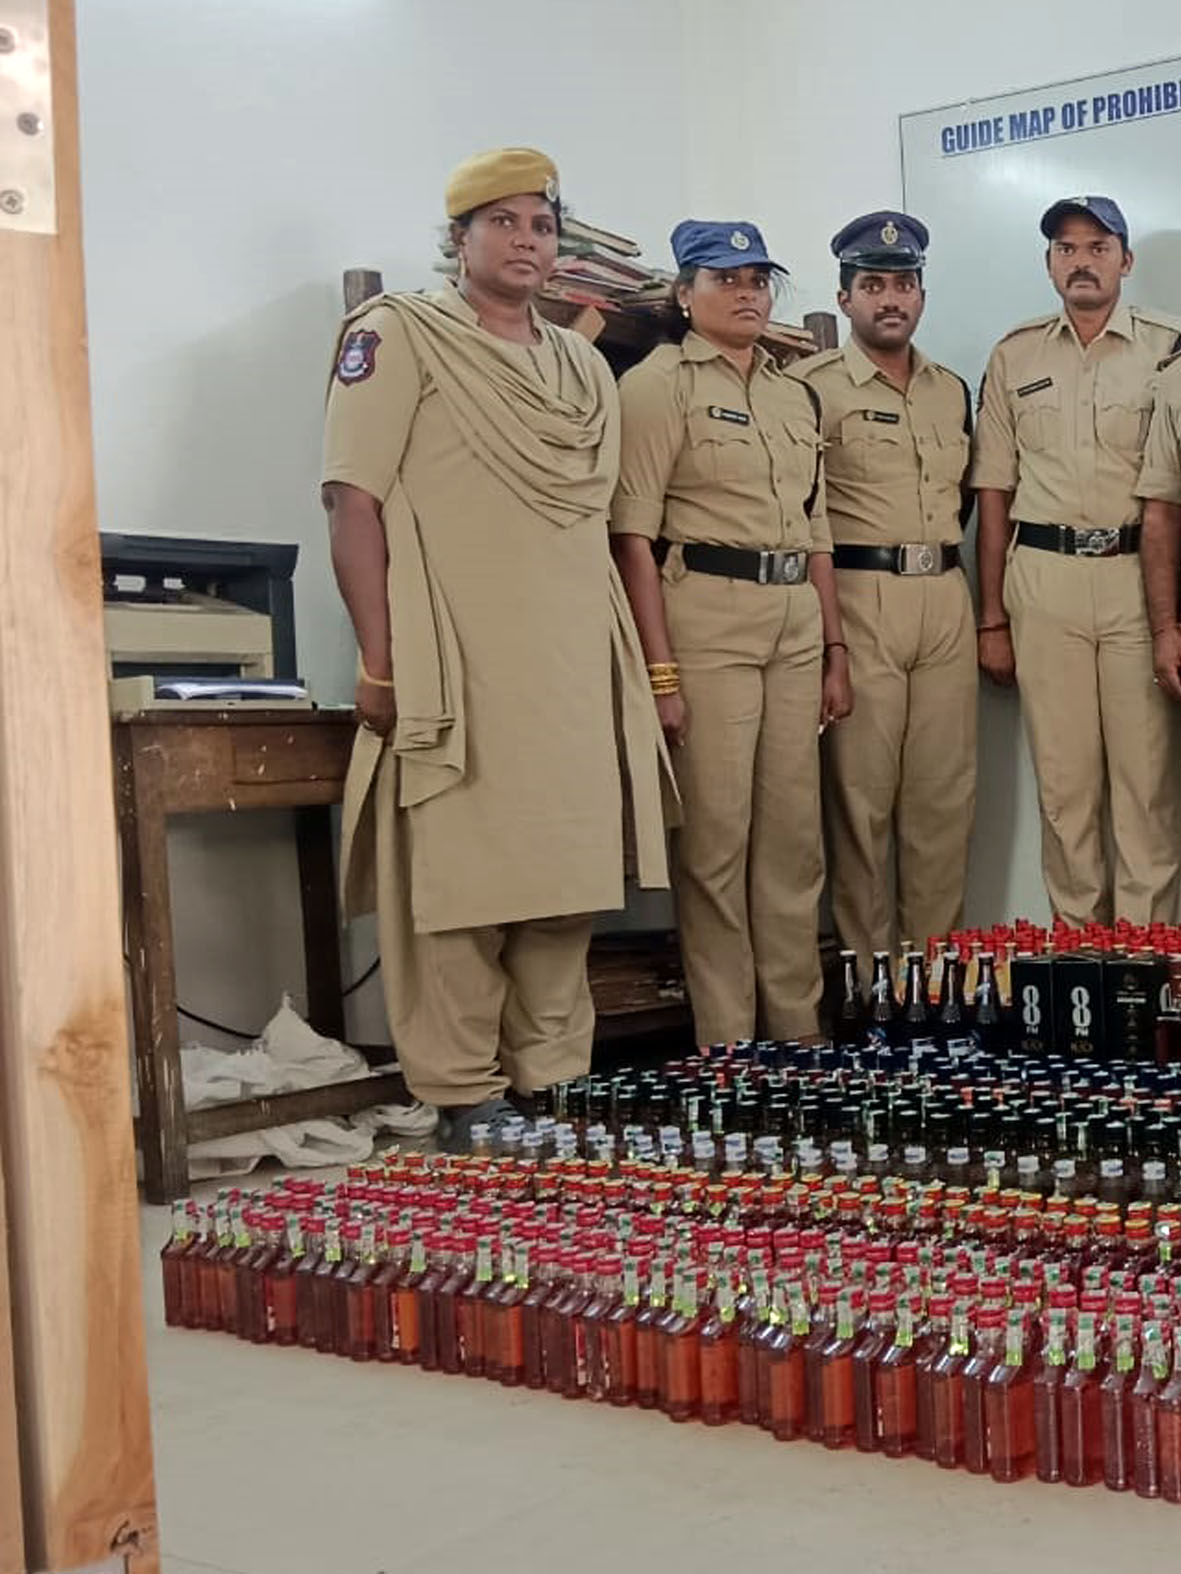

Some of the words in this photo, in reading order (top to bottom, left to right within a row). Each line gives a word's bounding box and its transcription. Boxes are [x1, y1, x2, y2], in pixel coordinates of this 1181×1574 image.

[941, 117, 1004, 153] GUIDE
[1009, 107, 1055, 140] MAP
[1061, 99, 1087, 130] OF
[1022, 985, 1041, 1026] 8
[1071, 986, 1092, 1027] 8
